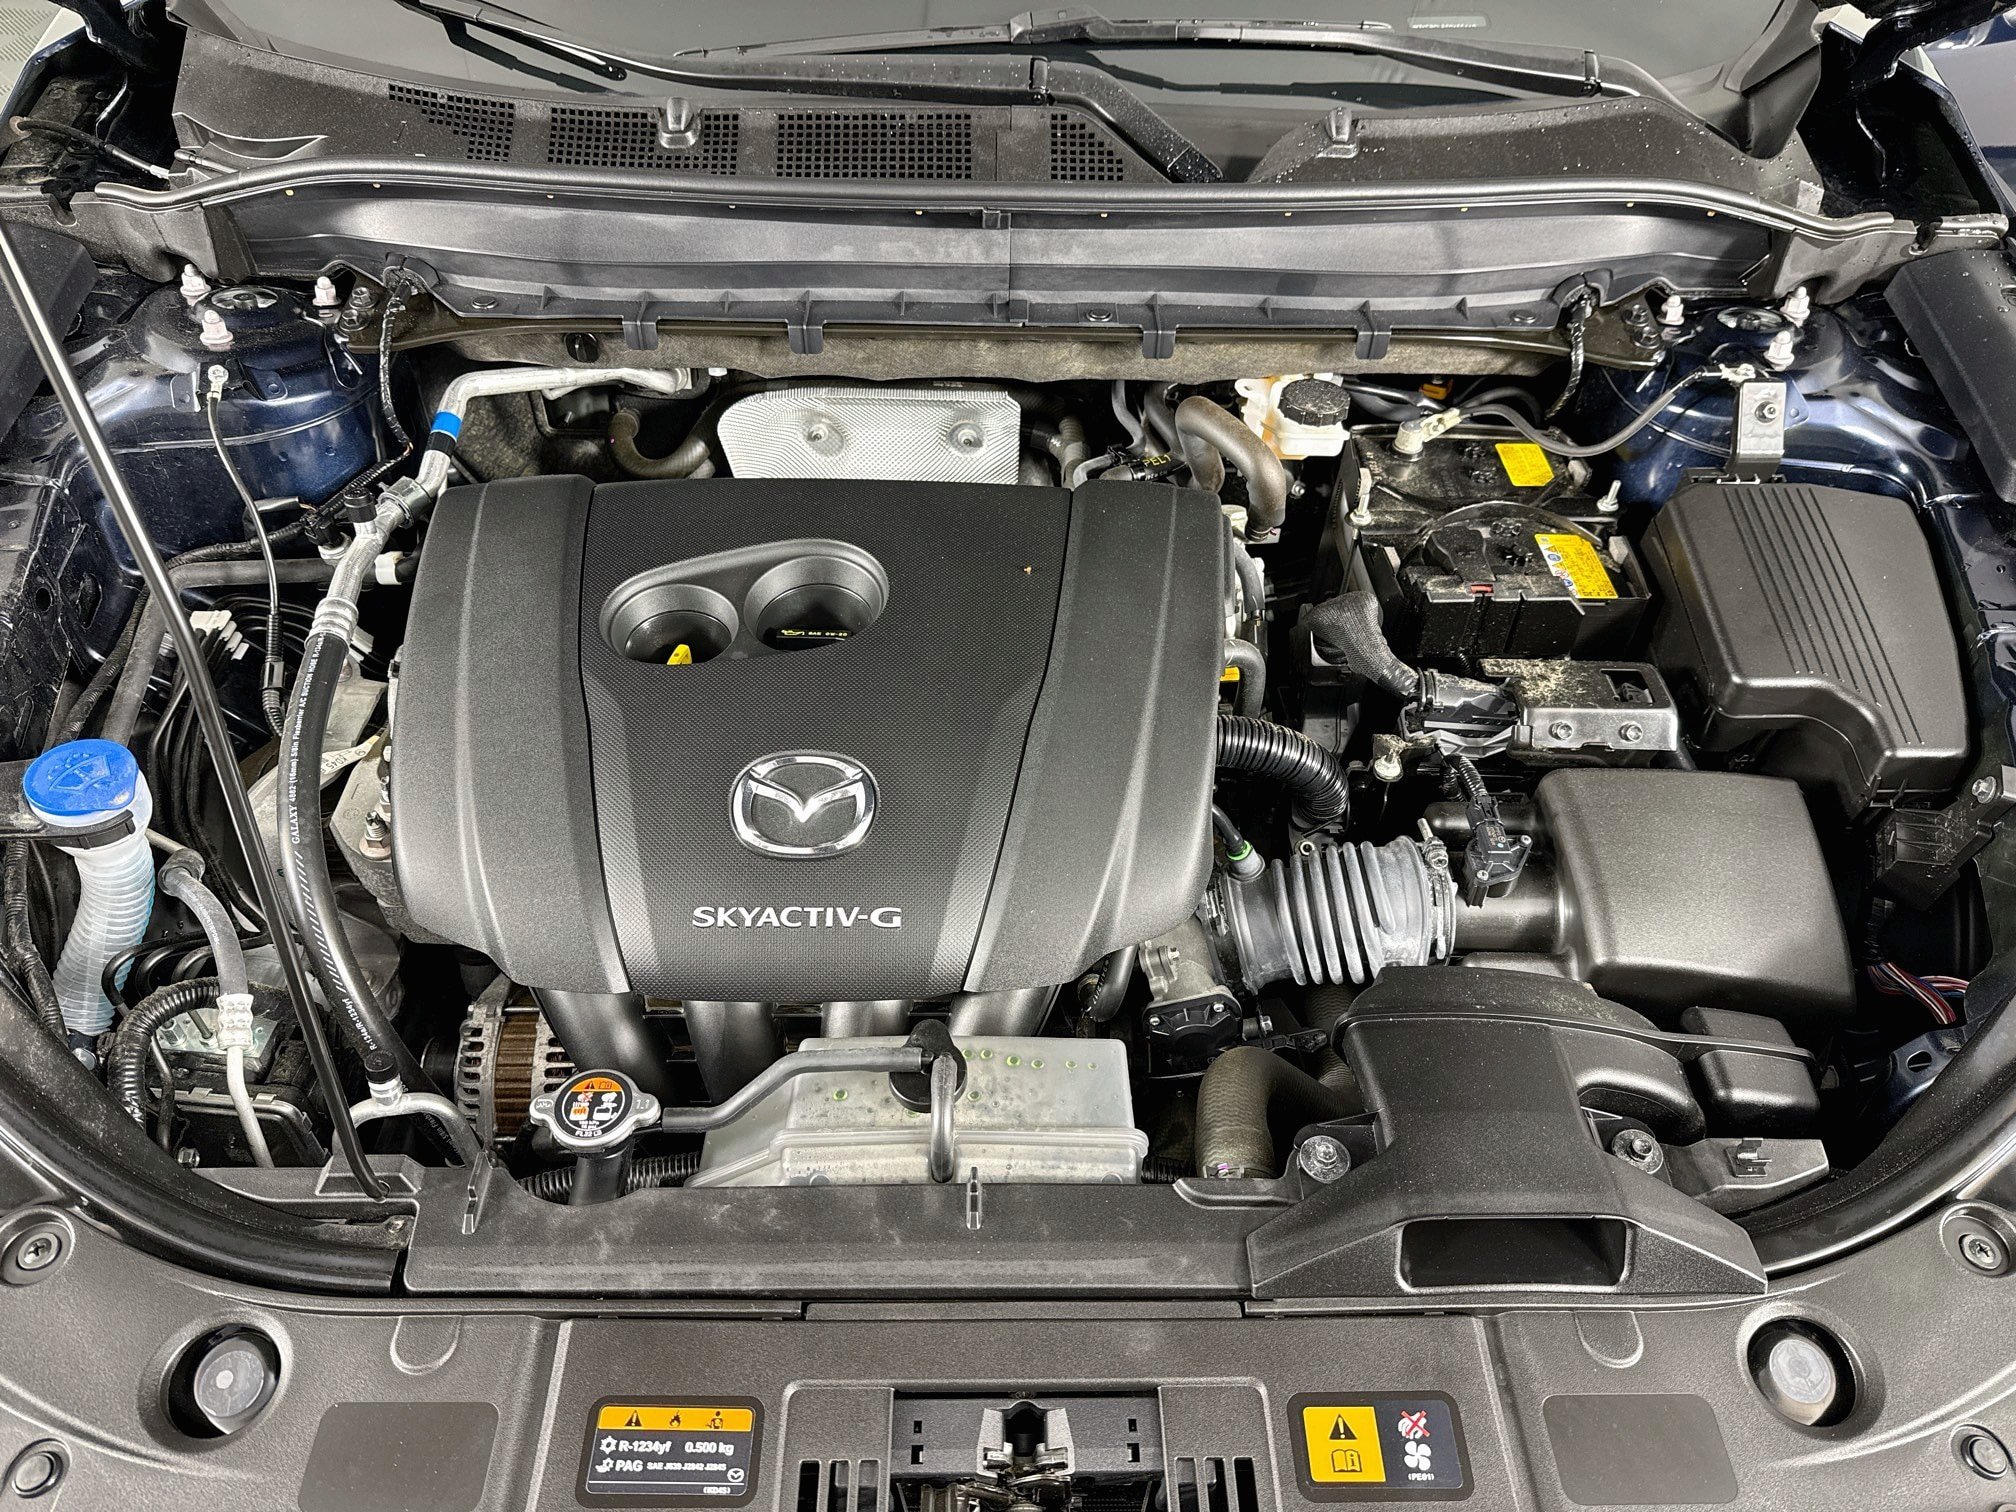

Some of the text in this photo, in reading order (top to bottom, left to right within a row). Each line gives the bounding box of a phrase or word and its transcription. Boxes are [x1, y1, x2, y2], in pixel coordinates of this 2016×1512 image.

[288, 804, 301, 845] GALAXY
[301, 673, 314, 697] SUCTION
[692, 906, 902, 929] SKYACTIV-G
[635, 1099, 650, 1110] 1.1
[618, 1440, 735, 1456] R-1234yf 0.500 kg
[615, 1460, 643, 1472] PAG
